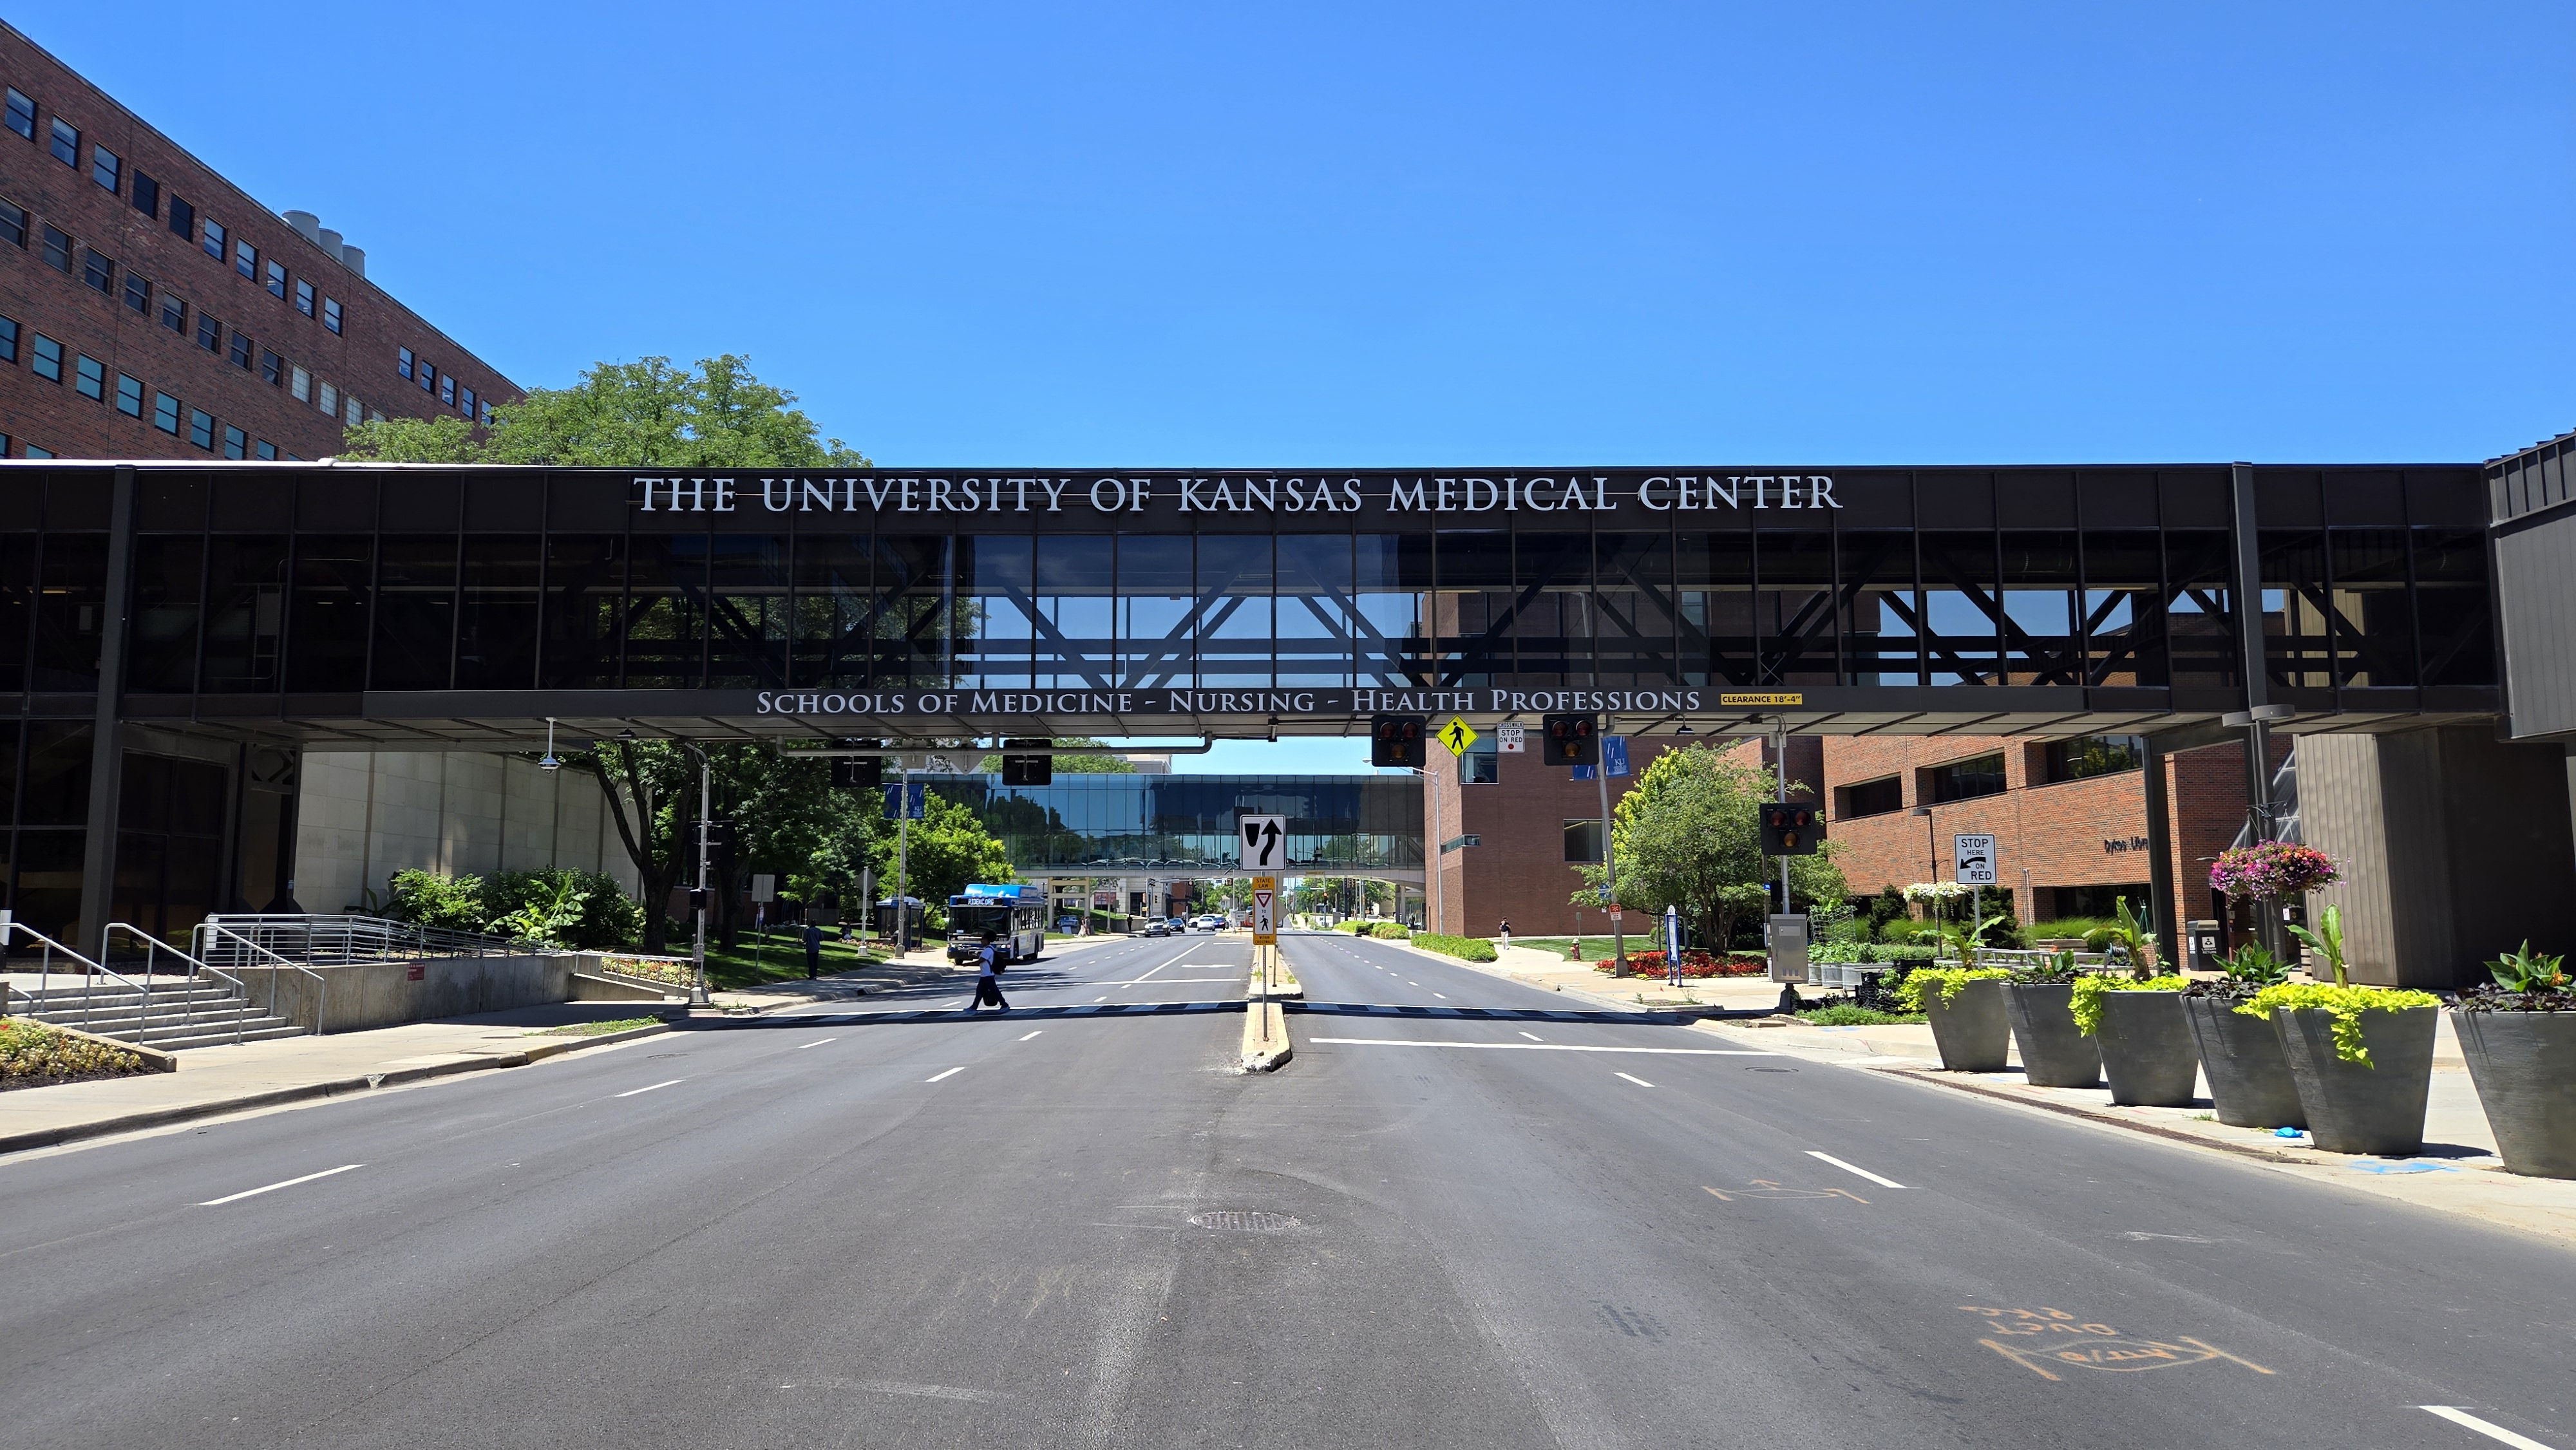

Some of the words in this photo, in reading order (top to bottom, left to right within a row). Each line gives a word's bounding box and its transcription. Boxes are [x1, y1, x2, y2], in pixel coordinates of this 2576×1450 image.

[634, 478, 735, 511] THE
[760, 478, 1071, 512] UNIVERSITY
[1090, 478, 1151, 512] OF
[1177, 478, 1362, 512] KANSAS
[1386, 476, 1617, 511] MEDICAL
[1638, 476, 1844, 510] CENTER
[757, 692, 904, 713] SCHOOLS
[918, 694, 958, 713] OF
[971, 691, 1132, 712] MEDICINE
[1169, 690, 1314, 711] NURSING
[1352, 690, 1474, 711] HEALTH
[1490, 689, 1700, 710] PROFESSIONS
[1615, 758, 1625, 766] KU
[1961, 838, 1989, 848] STOP
[1971, 871, 1992, 881] RED
[1987, 1321, 2117, 1336] DUCT
